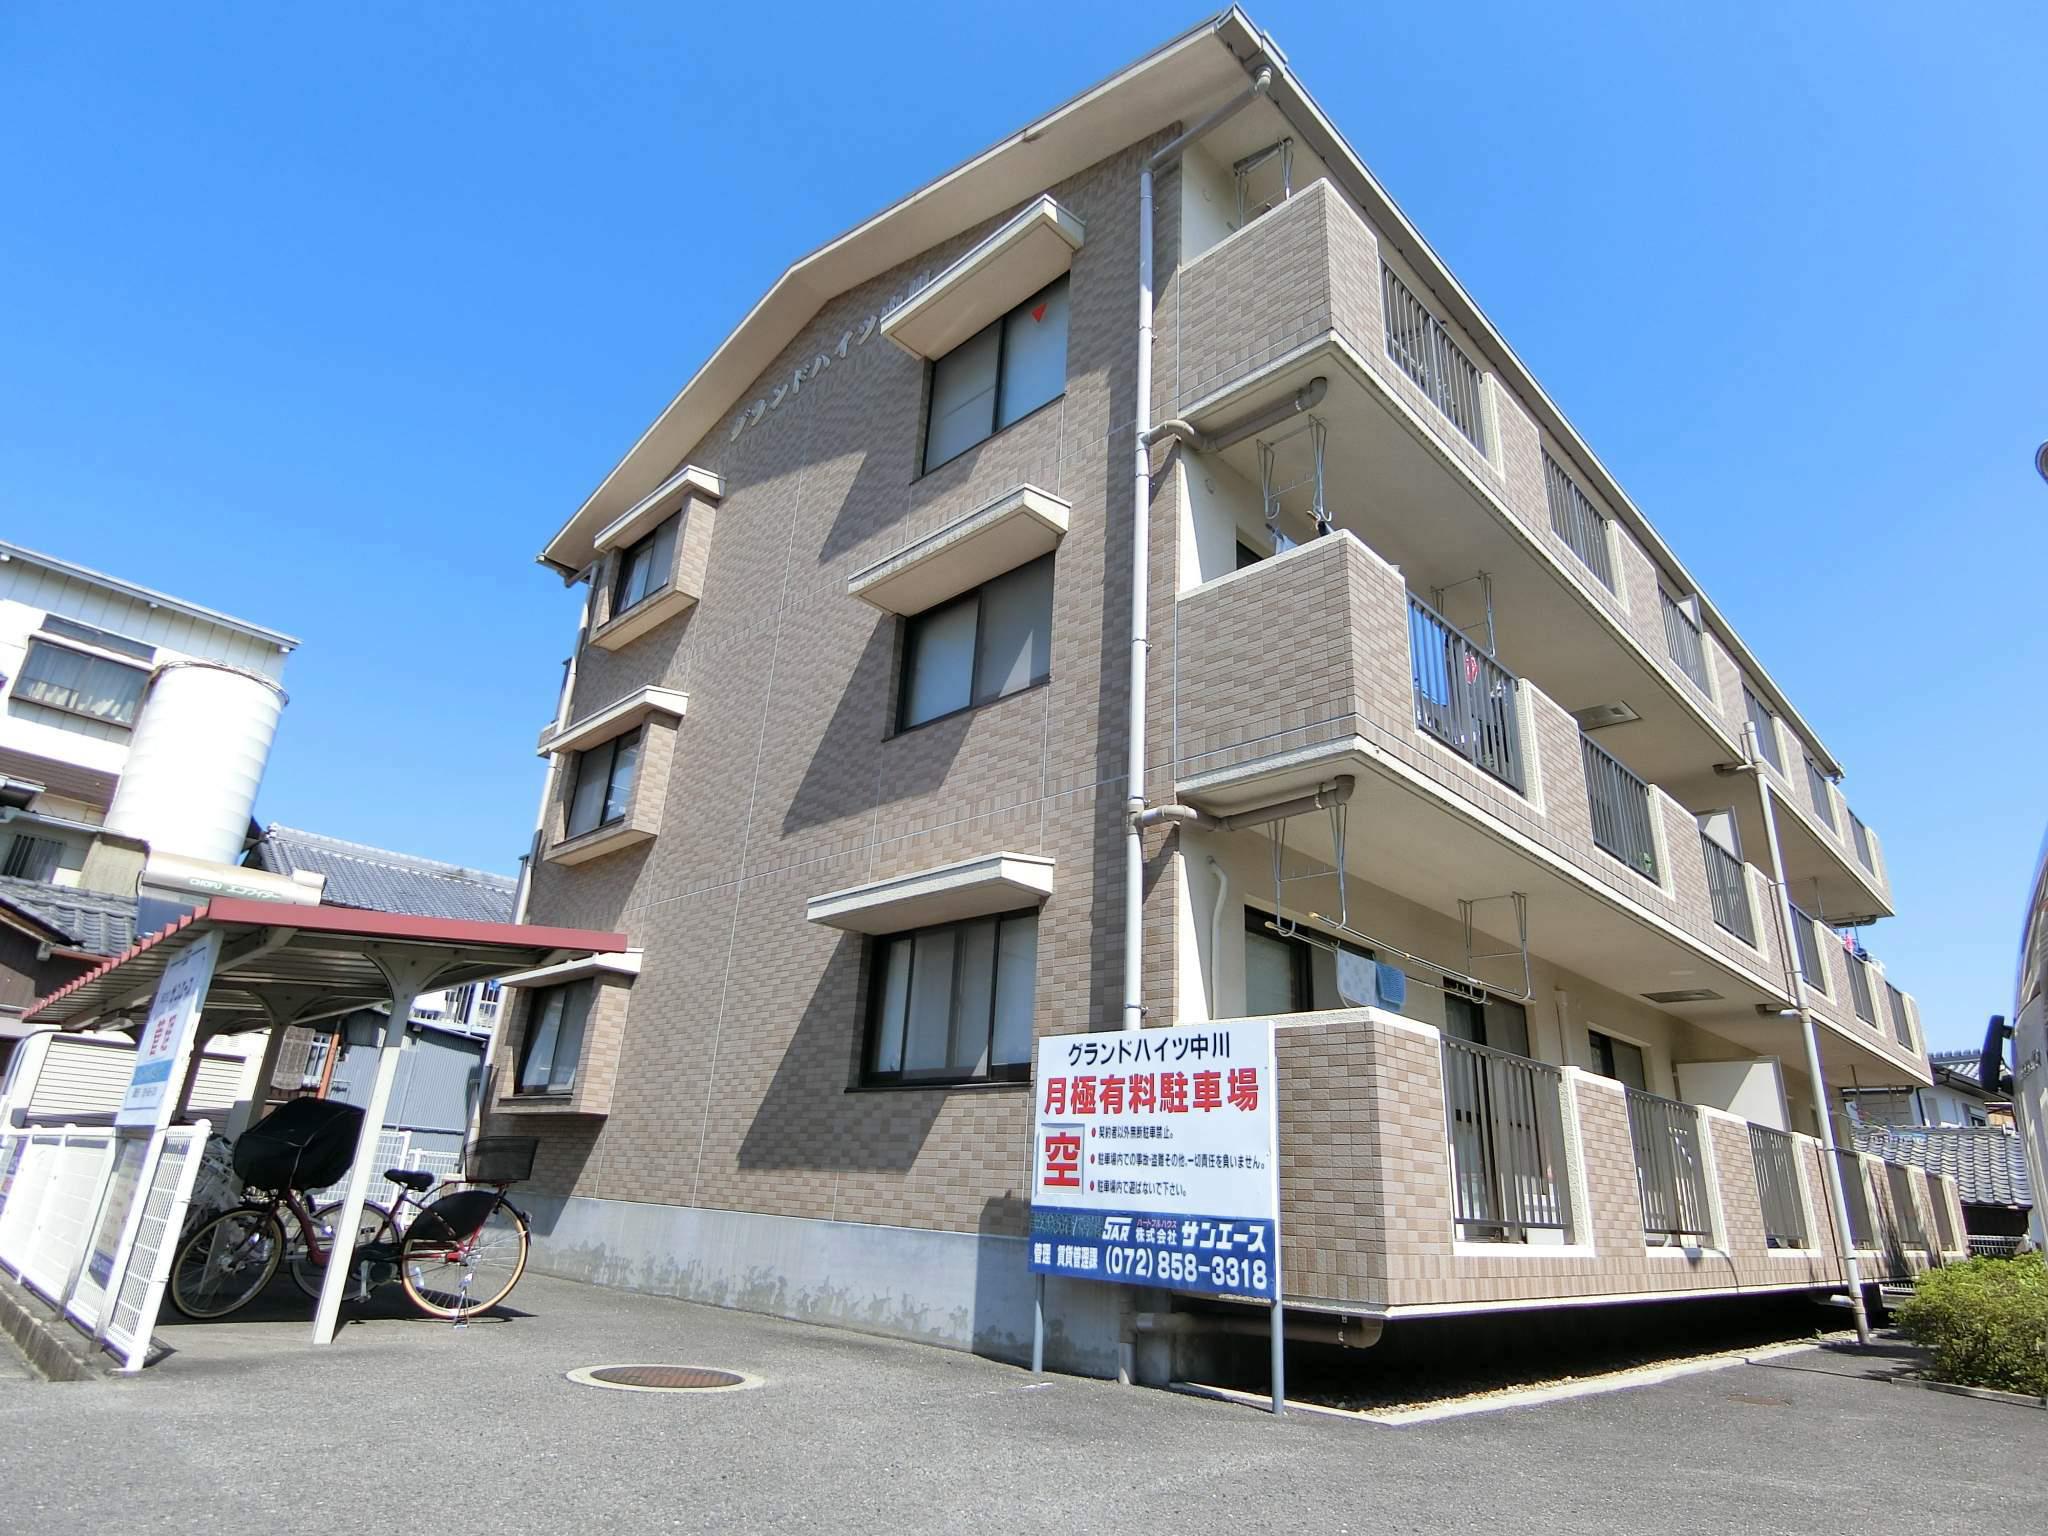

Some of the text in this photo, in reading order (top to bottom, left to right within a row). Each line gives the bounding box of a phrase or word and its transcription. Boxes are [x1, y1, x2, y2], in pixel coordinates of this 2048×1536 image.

[1068, 1032, 1230, 1066] グランドハイツ中川
[1044, 1067, 1259, 1115] 月極有料駐車場
[1044, 1131, 1081, 1187] 空
[1135, 1221, 1267, 1253] 株式会社 サンエース
[1136, 1218, 1178, 1228] ハートフルハウス
[1033, 1242, 1052, 1265] 管理
